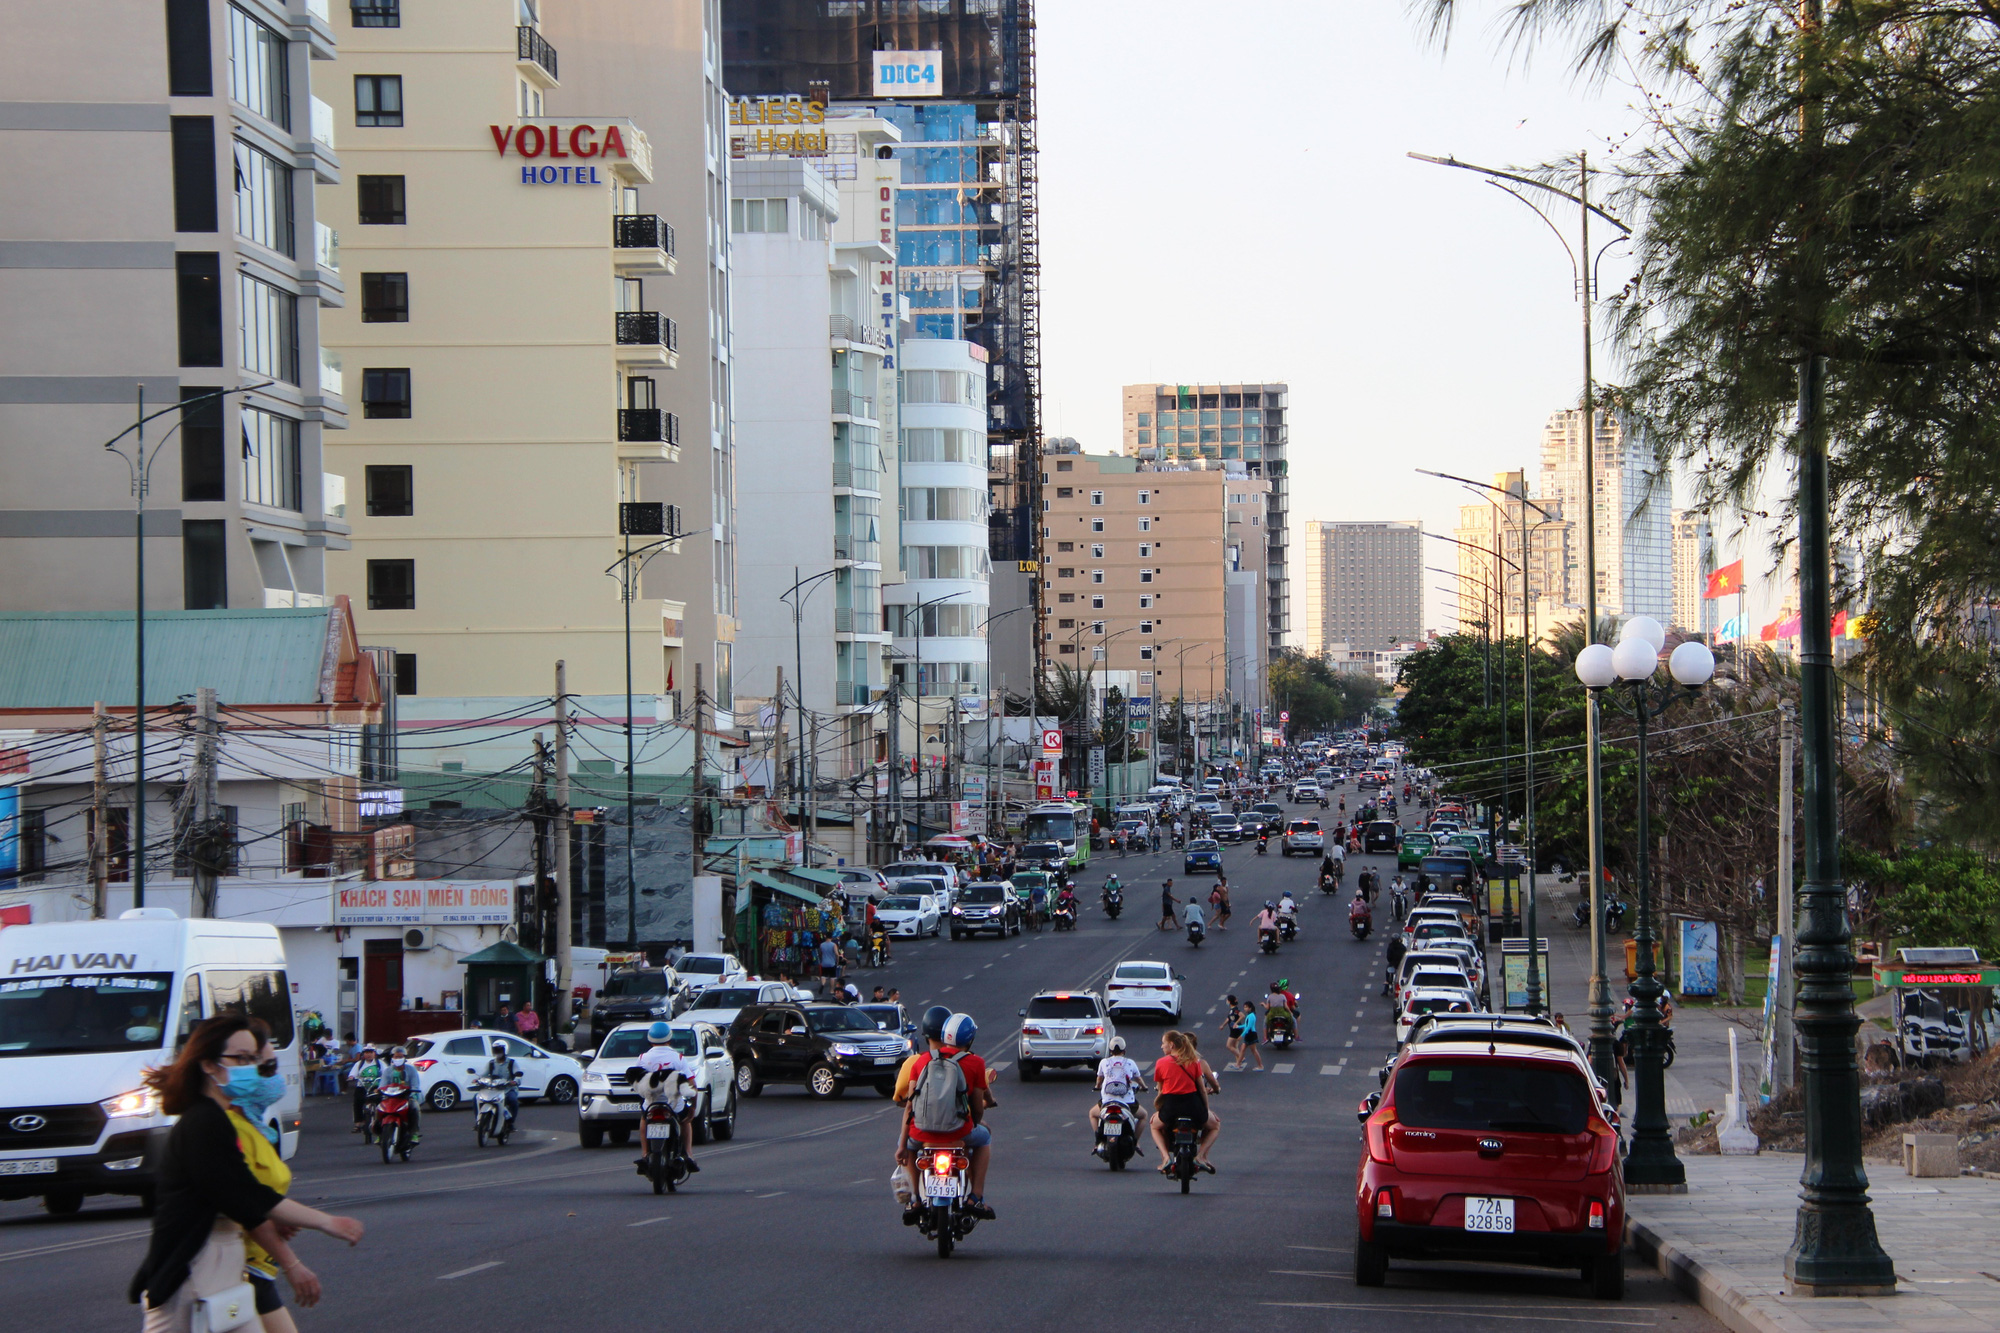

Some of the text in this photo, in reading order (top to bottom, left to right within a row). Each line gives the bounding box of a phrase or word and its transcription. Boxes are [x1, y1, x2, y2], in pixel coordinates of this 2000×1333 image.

[880, 64, 936, 84] DIC4
[489, 124, 628, 159] VOLGA
[756, 128, 825, 152] Hotel
[521, 165, 602, 184] HOTEL
[340, 885, 508, 910] KHÁCH SẠN MIỀN ĐÔNG
[9, 953, 137, 974] HAI VAN
[1405, 1131, 1436, 1139] morning
[1483, 1140, 1499, 1148] KIA
[1477, 1199, 1502, 1215] 72A
[1467, 1214, 1512, 1230] 328.58
